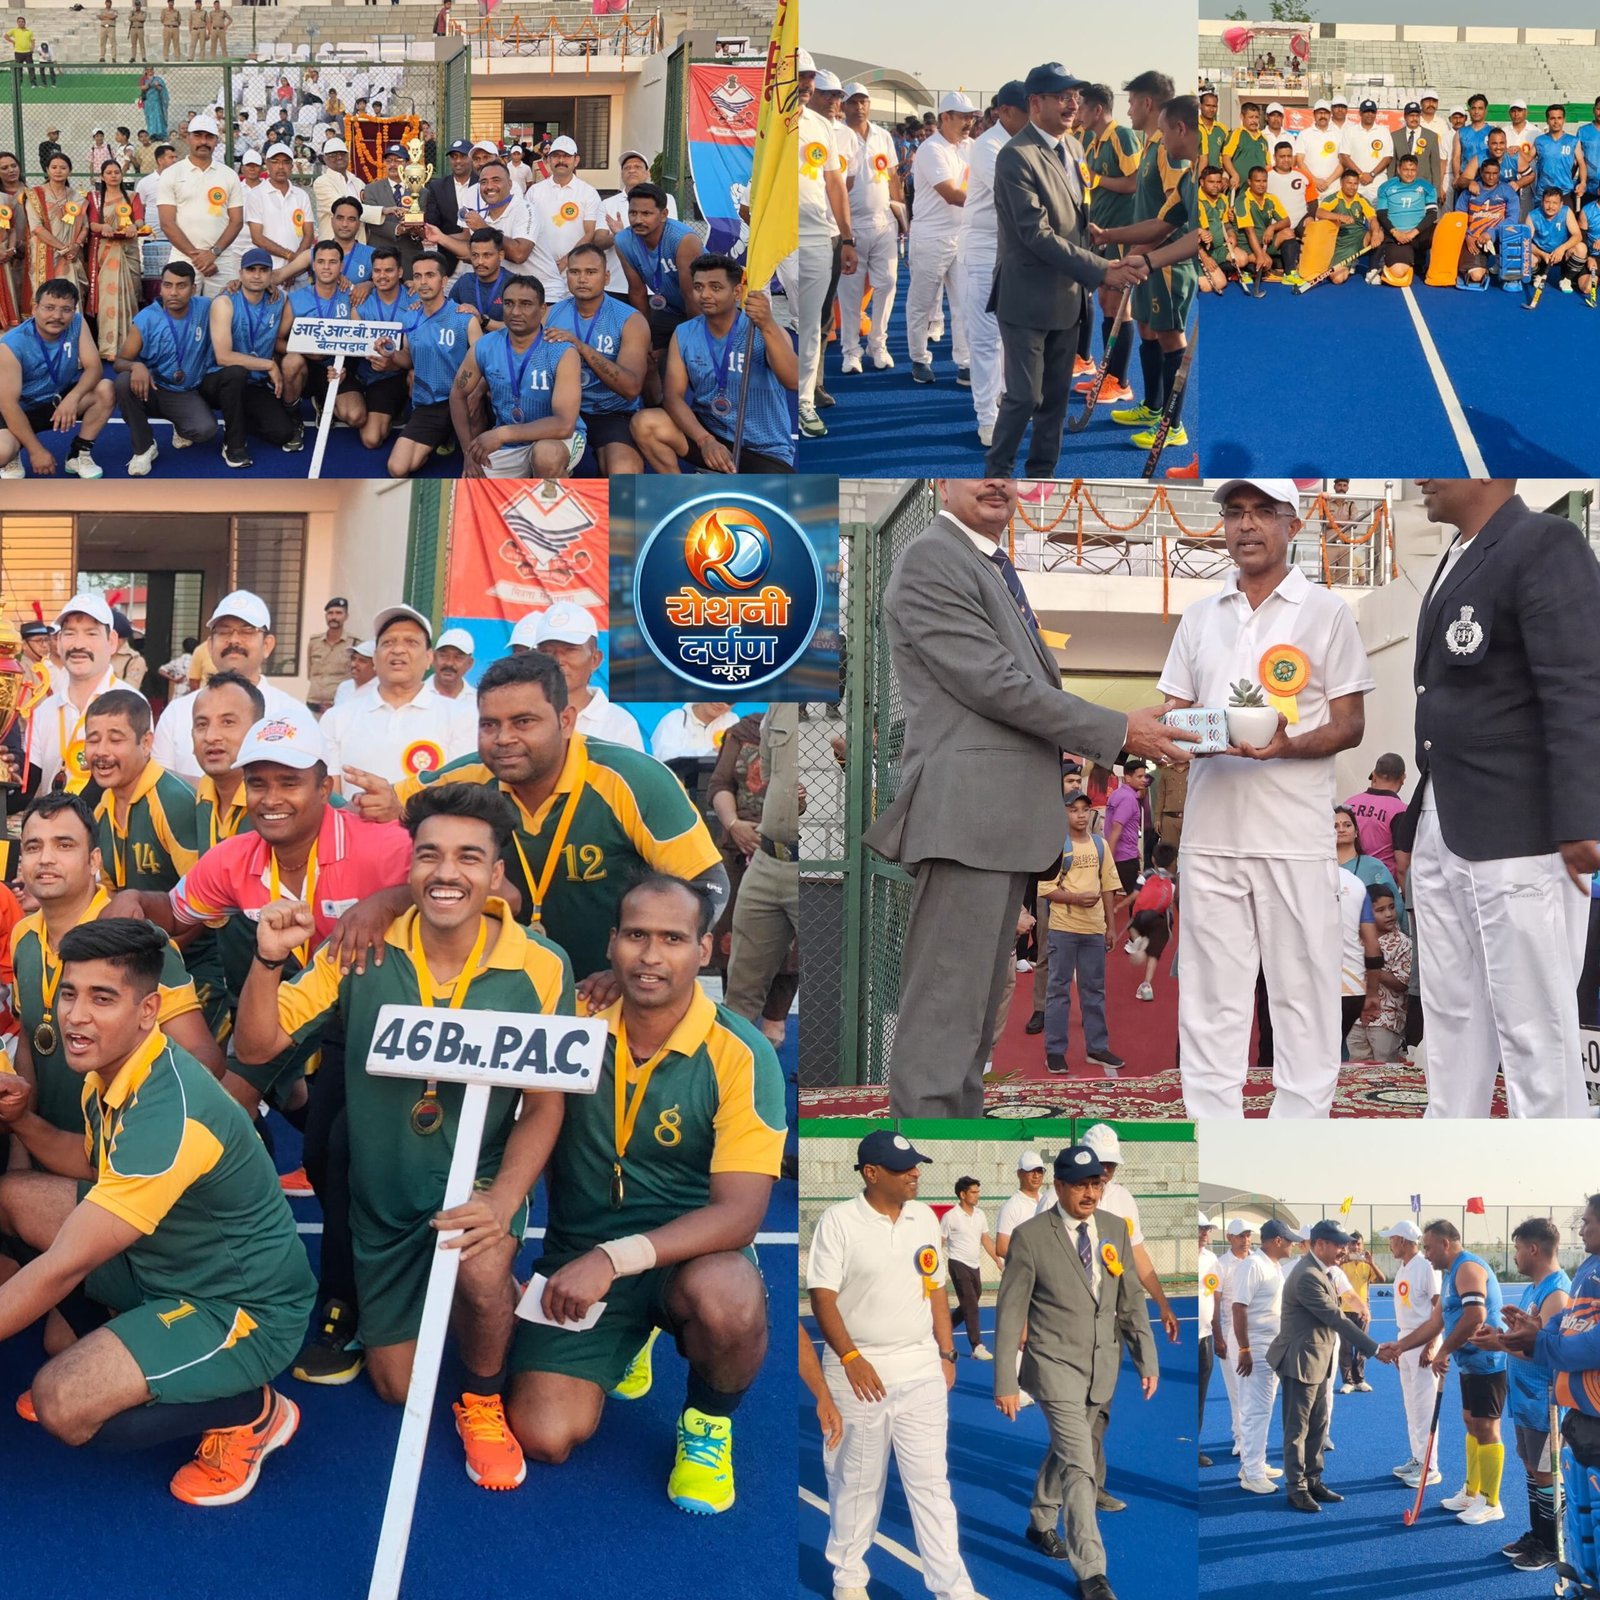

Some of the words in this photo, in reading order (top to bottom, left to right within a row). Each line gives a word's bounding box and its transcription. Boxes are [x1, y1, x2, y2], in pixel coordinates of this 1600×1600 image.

[1561, 145, 1571, 155] 10
[1504, 169, 1513, 178] 11
[1401, 197, 1412, 208] 77
[357, 264, 366, 278] 8
[661, 259, 678, 273] 14
[335, 303, 348, 318] 13
[438, 328, 455, 347] 10
[597, 335, 613, 354] 12
[63, 341, 72, 358] 7
[530, 370, 549, 390] 11
[131, 842, 161, 874] 14
[561, 843, 608, 881] 12
[653, 1103, 682, 1147] 8
